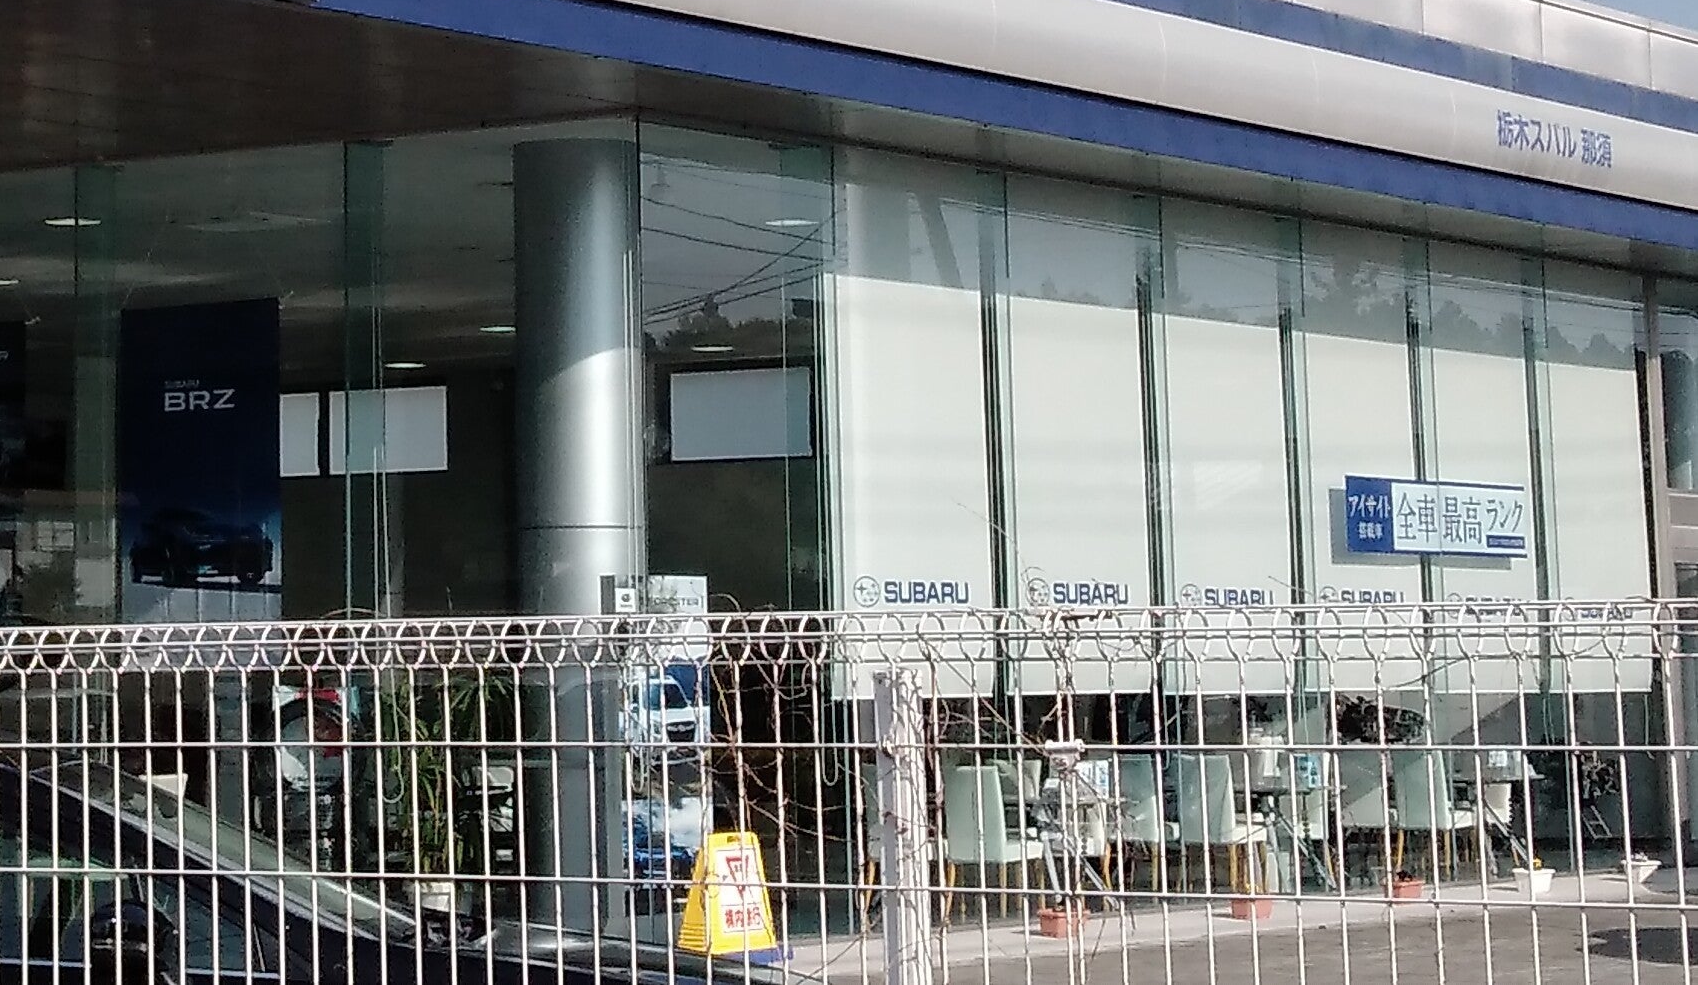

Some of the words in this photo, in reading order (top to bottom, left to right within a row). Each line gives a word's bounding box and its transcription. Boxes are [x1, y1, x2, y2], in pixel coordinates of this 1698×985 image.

[1497, 109, 1577, 159] 栃木スバル
[1580, 127, 1613, 169] 那須
[163, 388, 236, 412] BRZ
[1347, 494, 1391, 519] アイサイト
[884, 581, 970, 604] SUBARU
[1053, 582, 1129, 605] SUBARU
[1204, 588, 1275, 605] SUBARU
